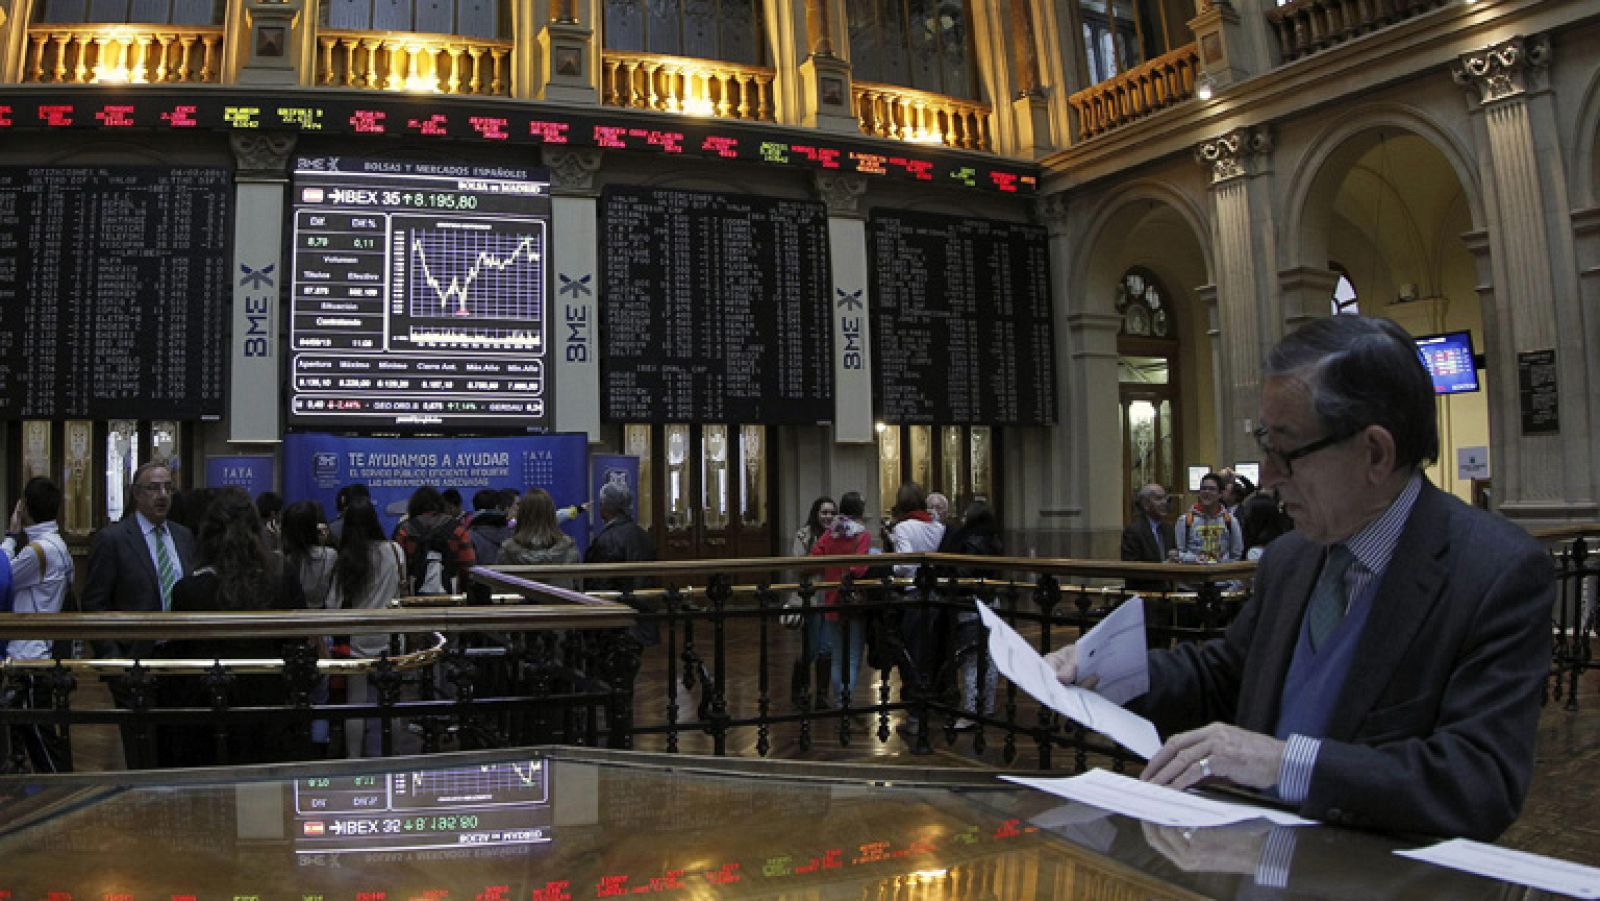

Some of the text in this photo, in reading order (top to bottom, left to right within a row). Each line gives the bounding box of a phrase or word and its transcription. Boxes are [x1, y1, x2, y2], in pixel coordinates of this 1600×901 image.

[364, 162, 528, 178] BOLSAS Y MERCADOS ESPAÑOLES
[341, 189, 478, 209] IBEX 35 8.195,80
[244, 296, 267, 357] BME
[566, 304, 586, 363] BME
[842, 317, 861, 370] BME
[348, 452, 509, 467] TE AYUDAMOS A AYUDAR
